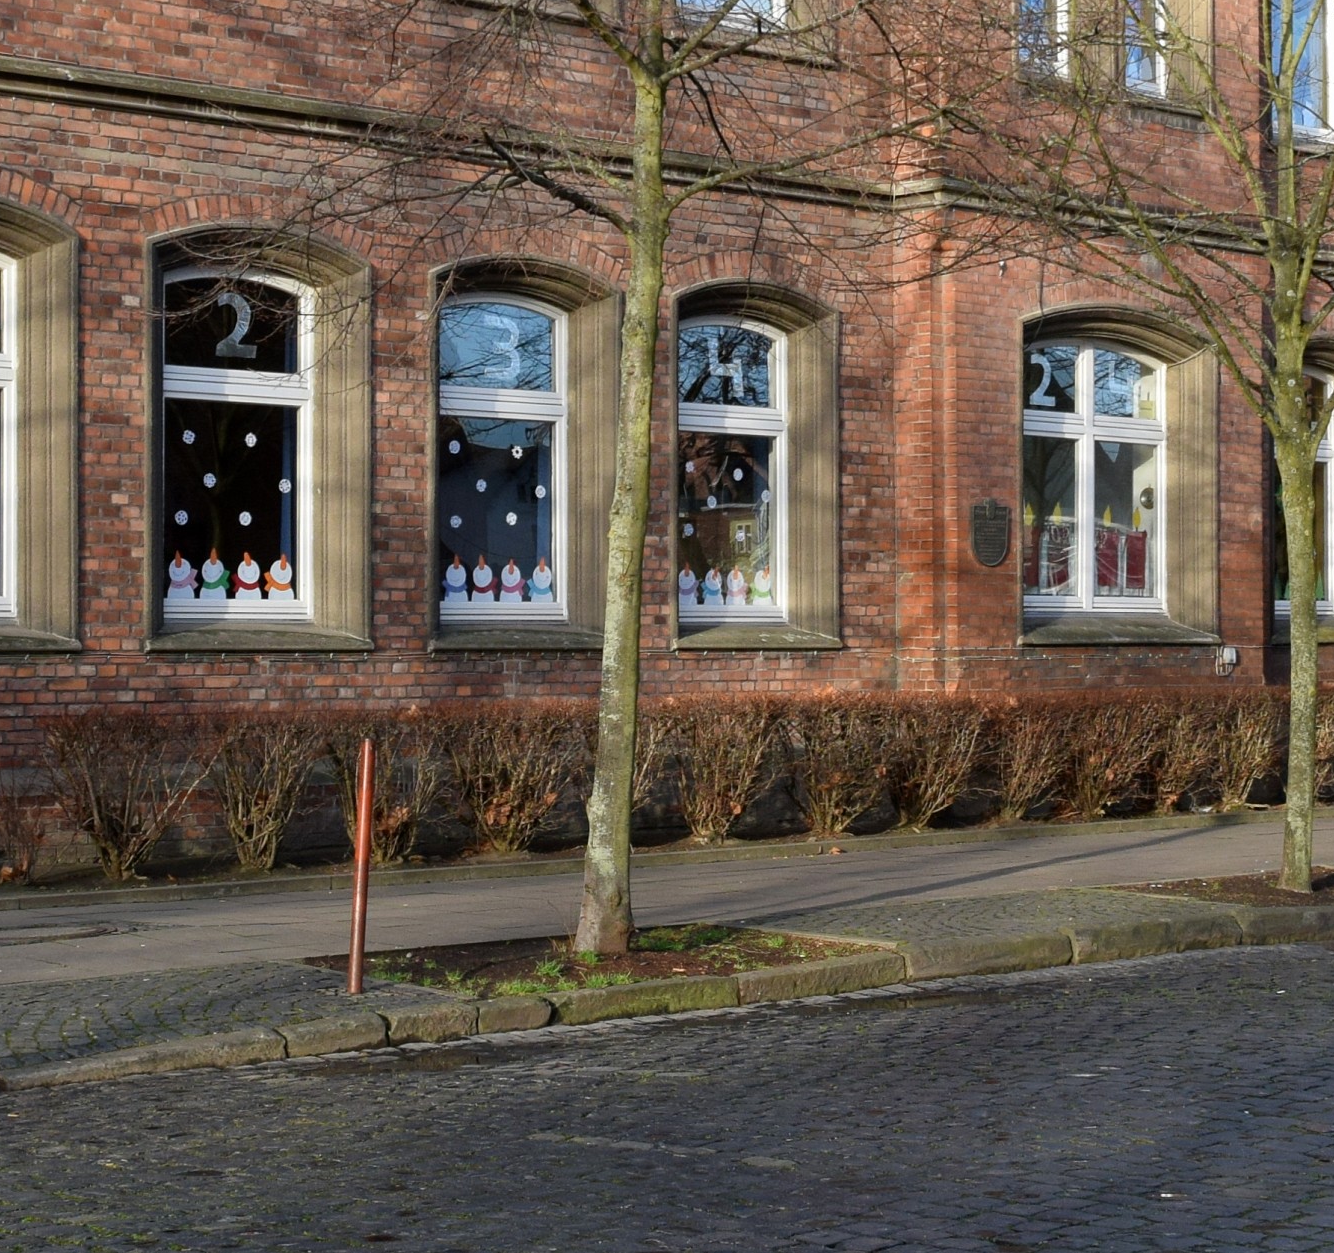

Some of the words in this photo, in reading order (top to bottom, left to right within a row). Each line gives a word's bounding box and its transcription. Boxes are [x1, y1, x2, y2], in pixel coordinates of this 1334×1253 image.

[215, 292, 258, 359] 2
[483, 313, 520, 381] 3
[708, 337, 745, 398] 4
